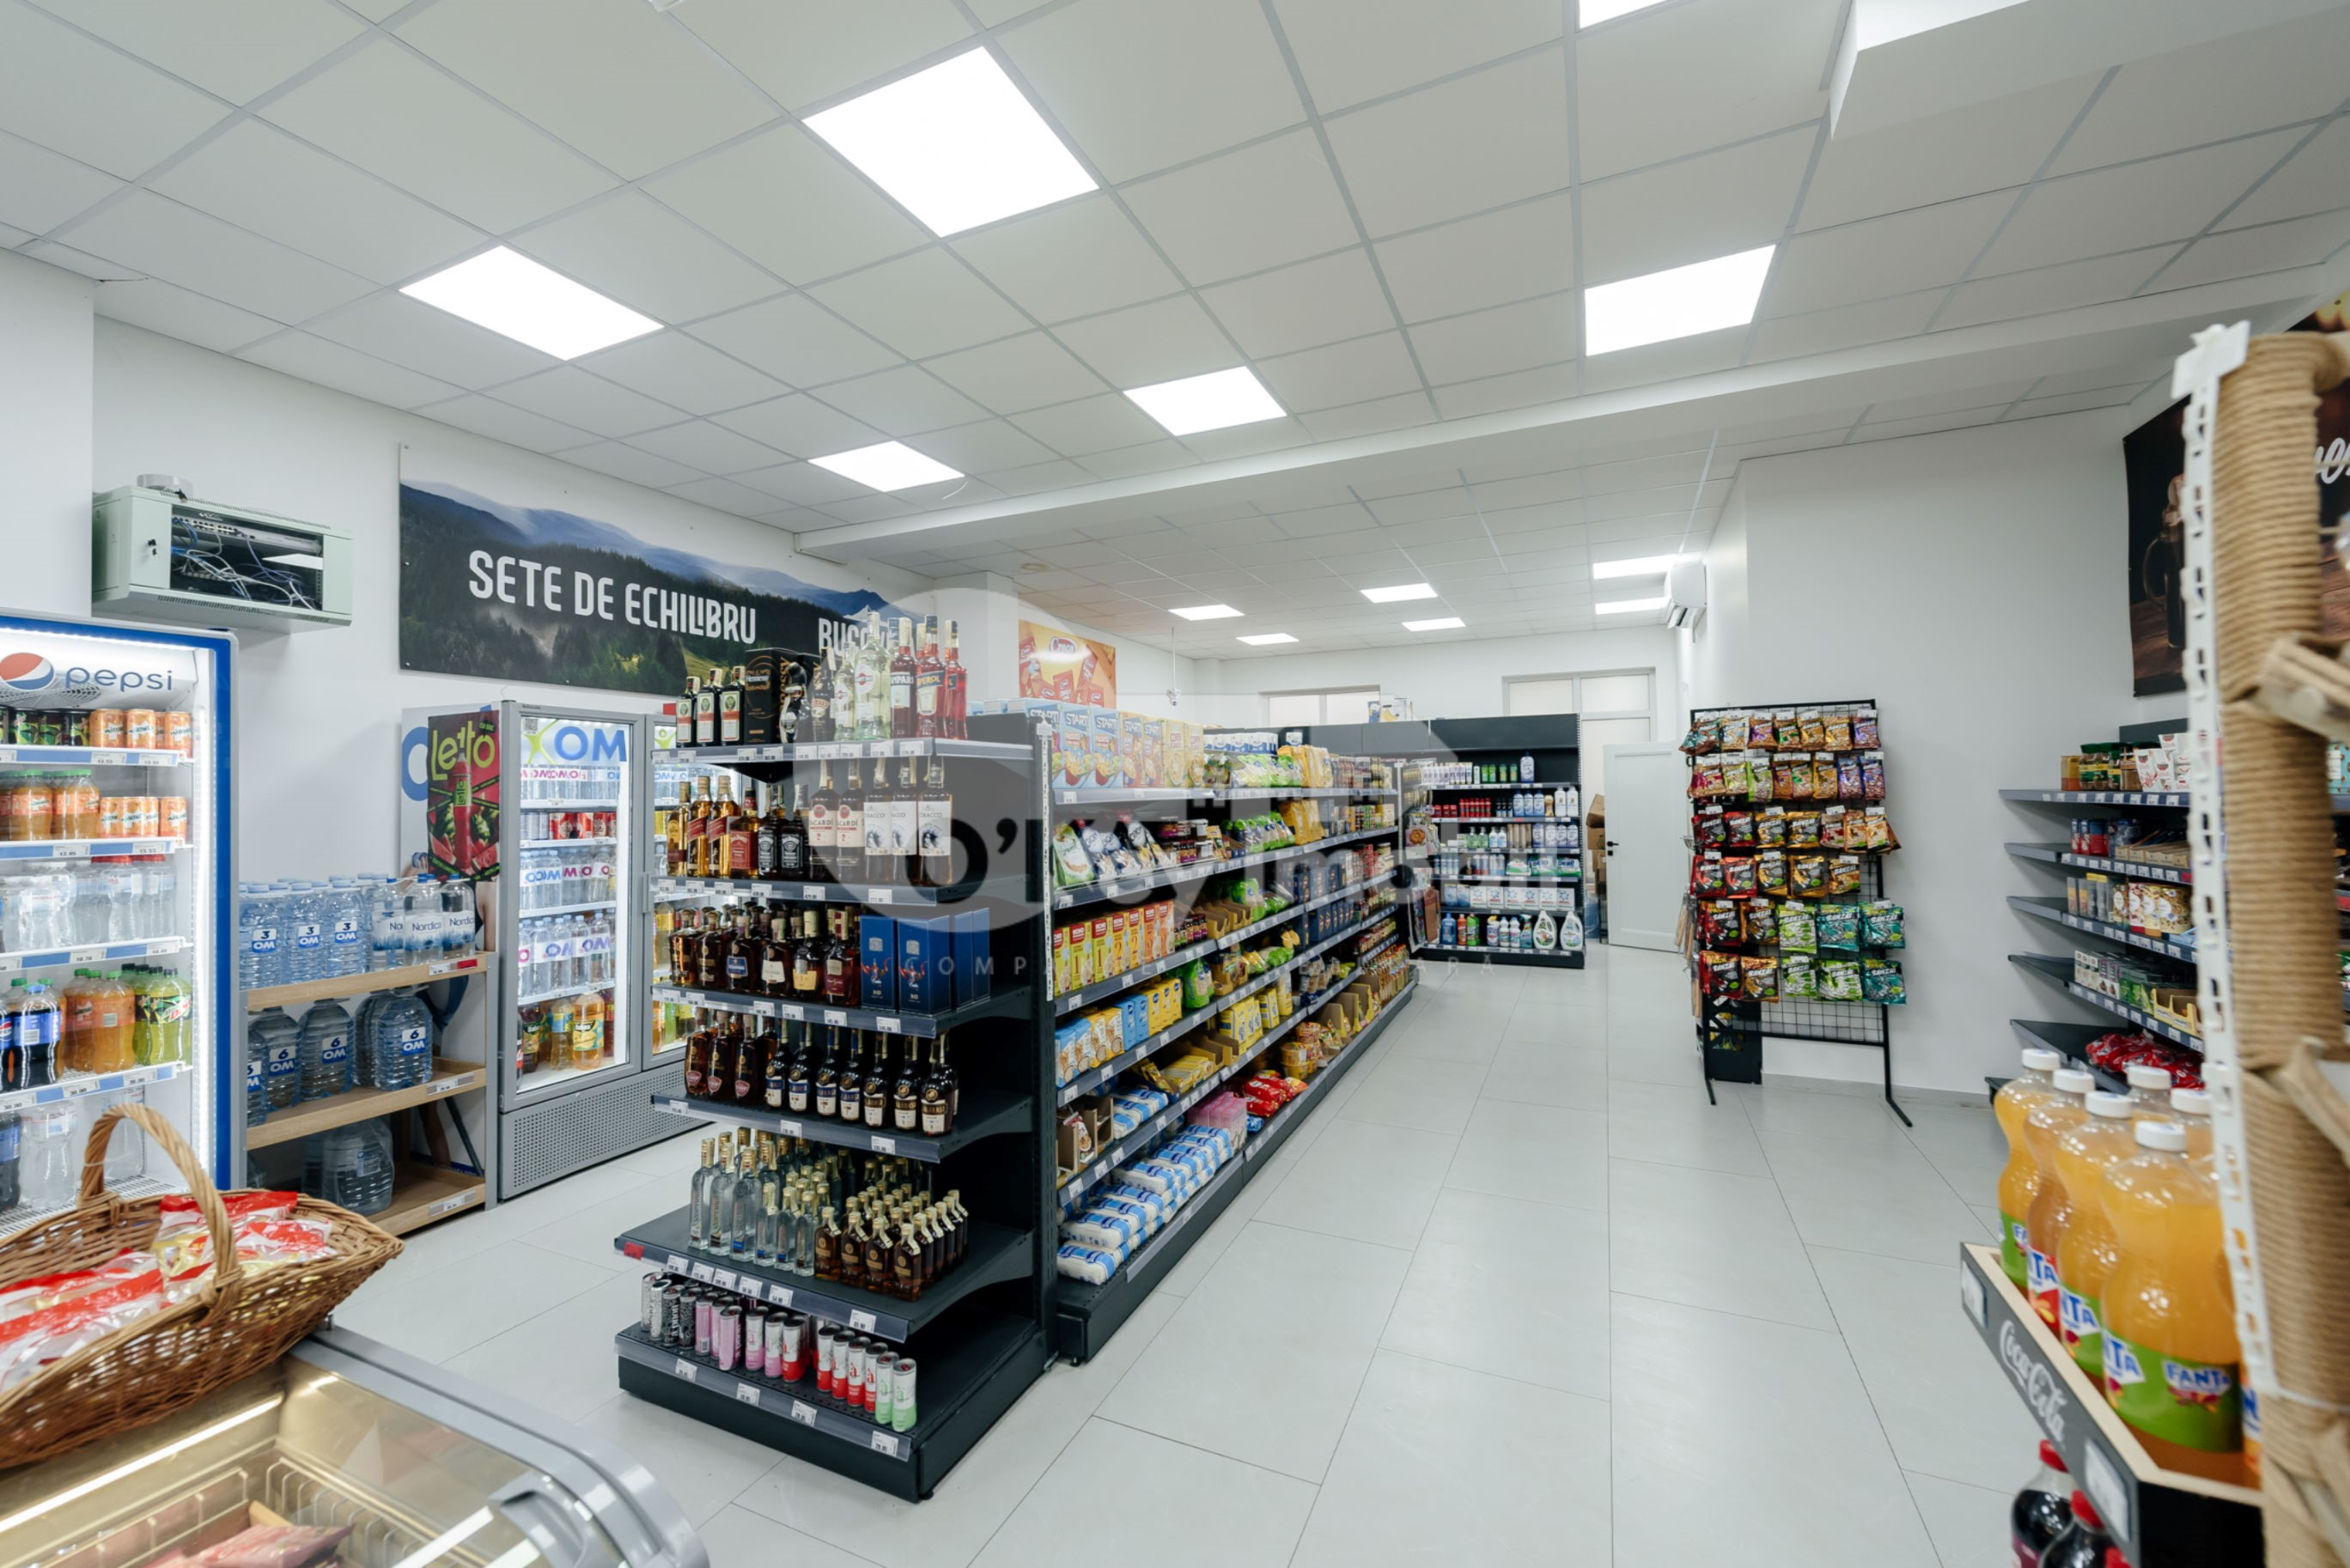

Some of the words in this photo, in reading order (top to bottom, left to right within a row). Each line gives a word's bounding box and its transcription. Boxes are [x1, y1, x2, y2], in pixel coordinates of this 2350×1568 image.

[468, 550, 563, 612] SETE
[574, 570, 614, 621] DE
[624, 582, 756, 645] ECHILIBRU
[65, 666, 173, 692] pepsi
[306, 927, 315, 935] 3
[343, 922, 351, 931] 3
[260, 930, 271, 939] 3
[336, 932, 356, 940] OM
[253, 941, 276, 951] OM
[410, 1029, 419, 1040] 6
[331, 1037, 341, 1048] 6
[402, 1040, 425, 1051] OM
[277, 1048, 289, 1060] 6
[322, 1048, 346, 1060] OM
[270, 1061, 294, 1073] OM
[2164, 1363, 2230, 1390] FANTA
